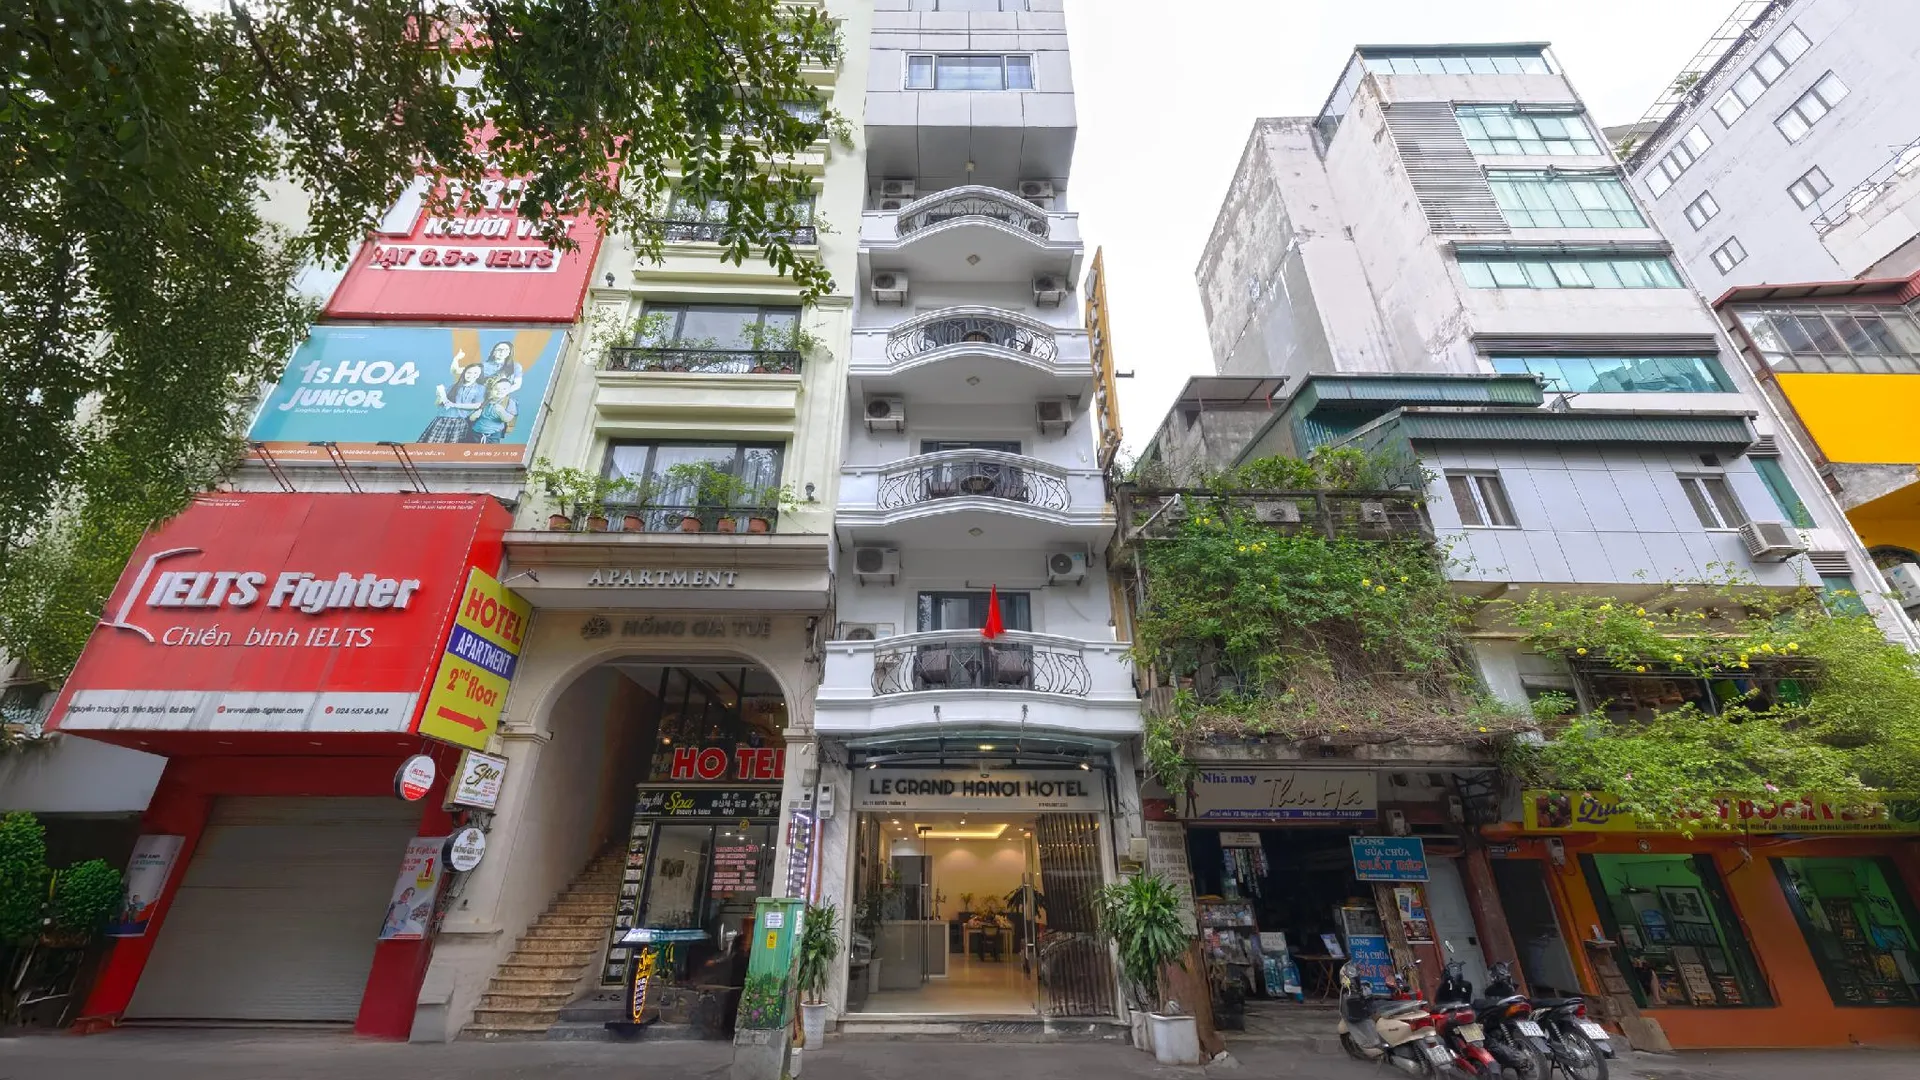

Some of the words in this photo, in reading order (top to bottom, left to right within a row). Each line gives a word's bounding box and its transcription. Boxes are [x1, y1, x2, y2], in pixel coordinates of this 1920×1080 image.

[419, 249, 479, 266] 6.5+
[485, 249, 554, 268] IELTS
[587, 568, 738, 588] APARTMENT
[146, 571, 267, 608] IELTS
[266, 571, 420, 615] Fighter
[464, 587, 522, 646] HOTEL
[691, 617, 726, 638] GIA
[162, 623, 233, 647] Chiến
[304, 627, 375, 647] IELTS
[455, 631, 513, 676] APARTMENT
[465, 674, 499, 708] floor
[465, 763, 501, 787] Spa
[869, 779, 892, 795] LE
[895, 779, 955, 796] GRAND
[962, 780, 1021, 797] HANOI
[1026, 781, 1089, 797] HOTEL
[664, 791, 696, 816] Spa
